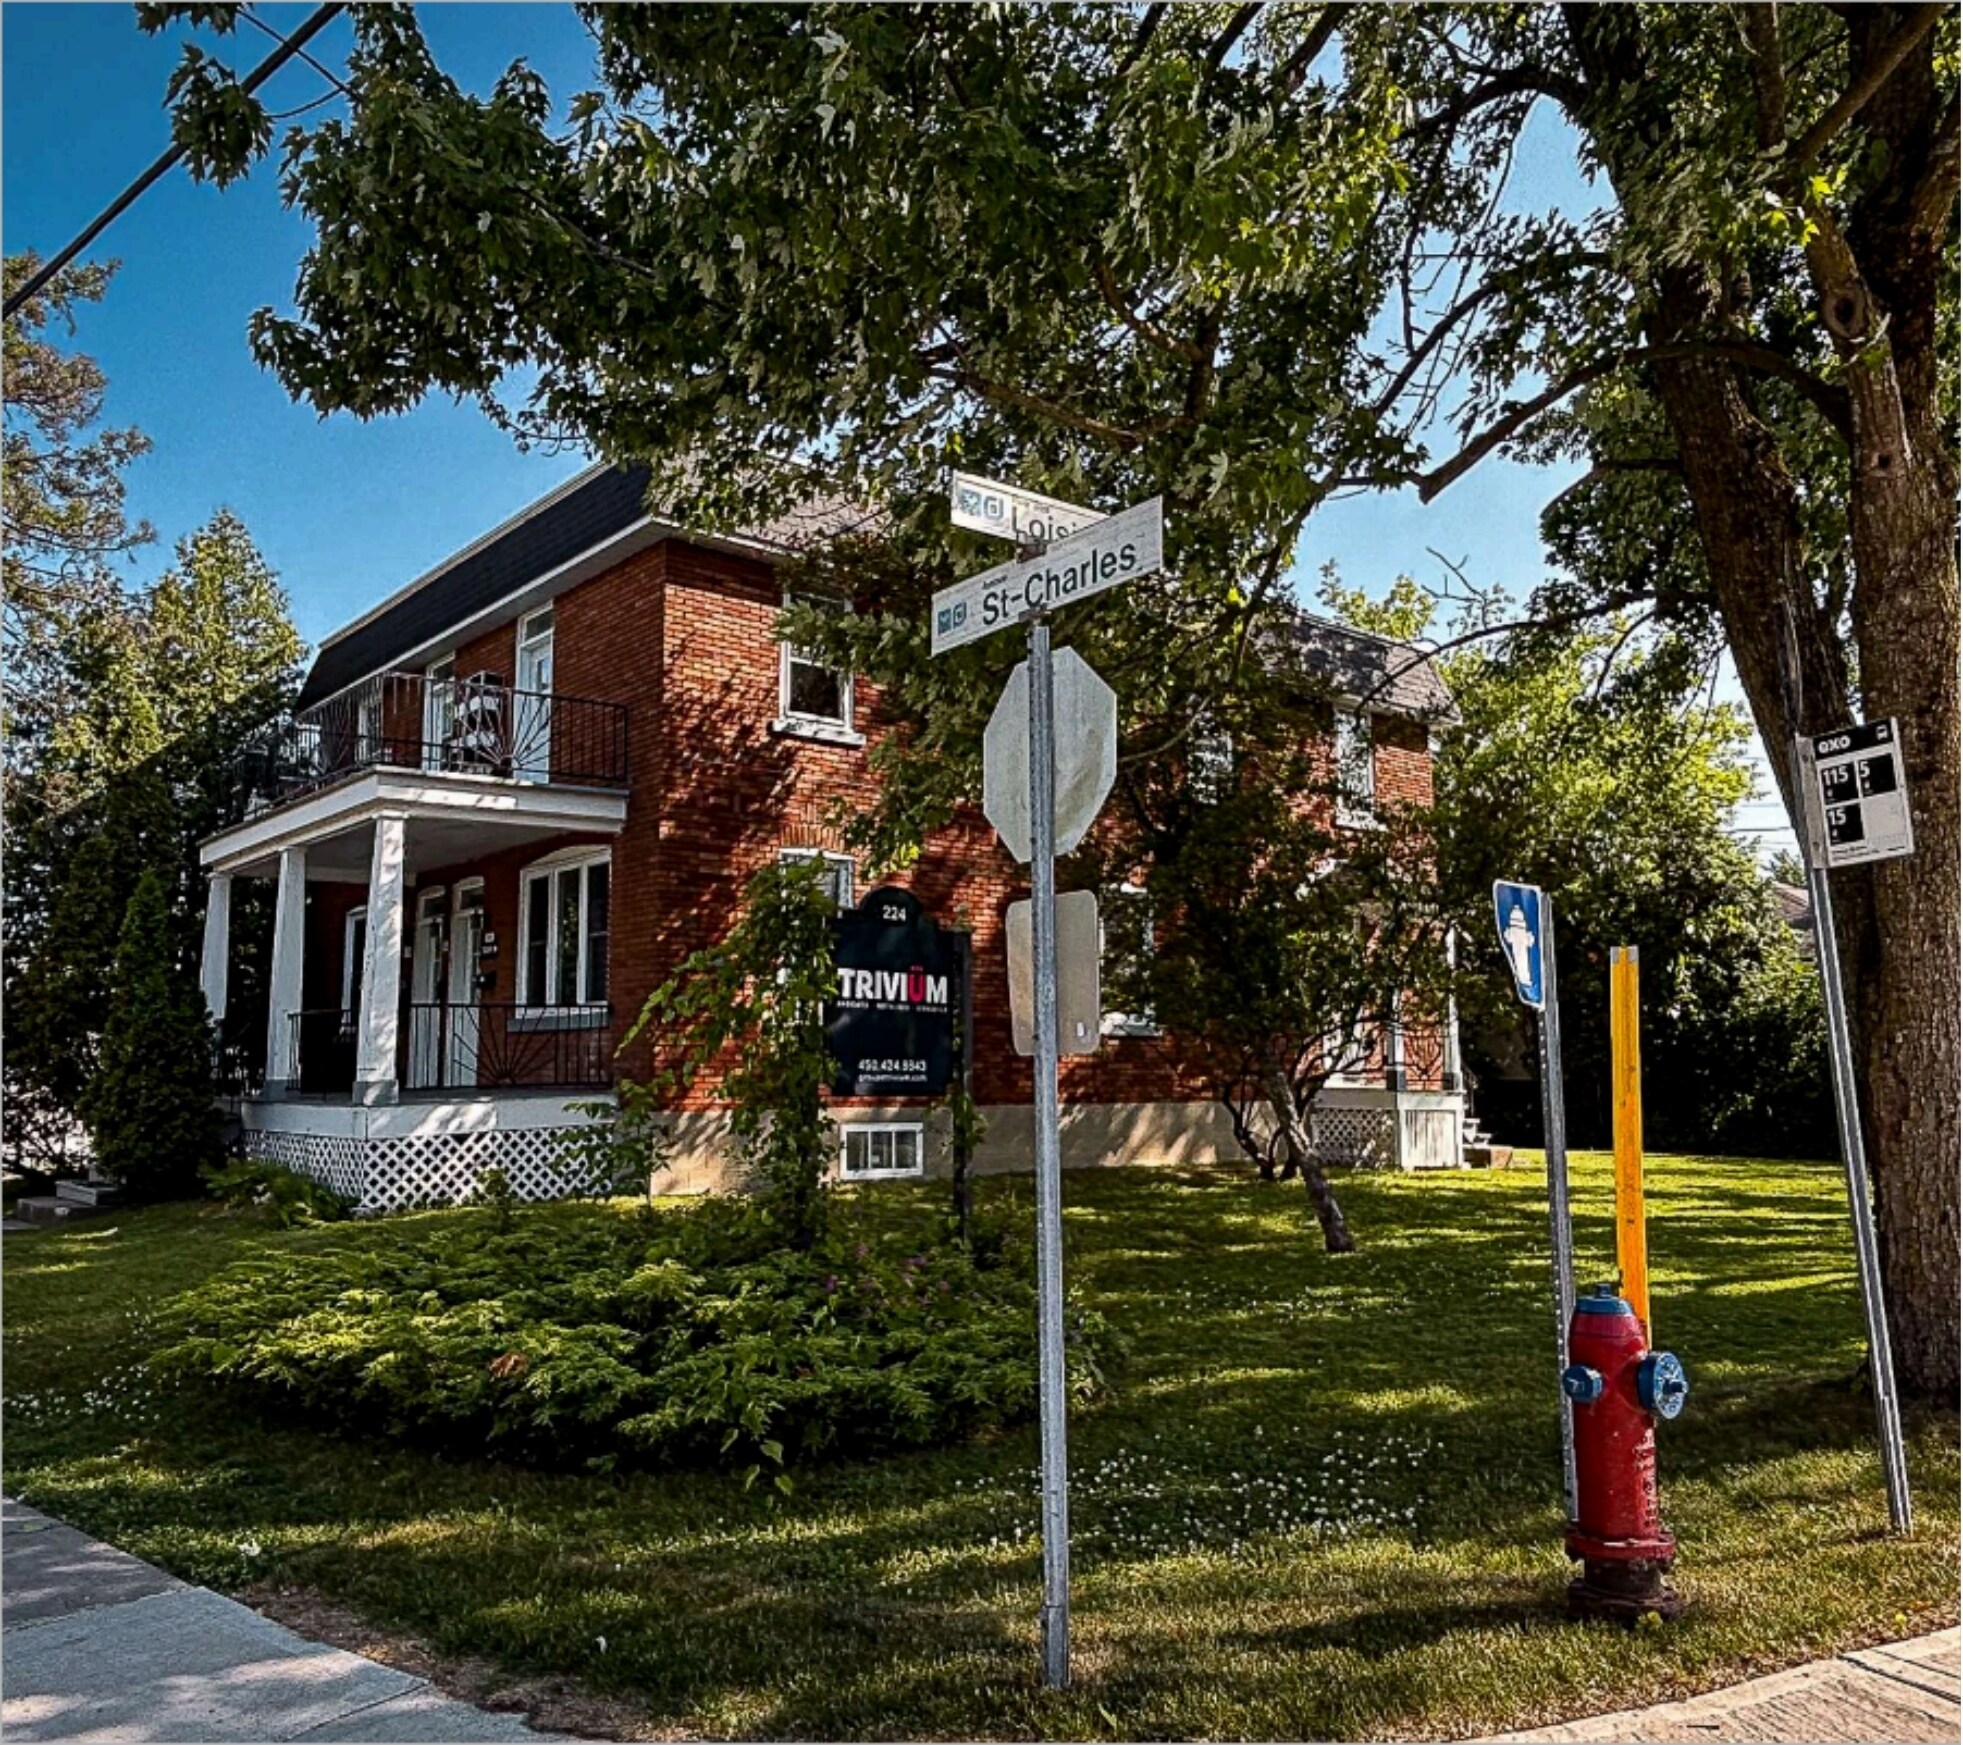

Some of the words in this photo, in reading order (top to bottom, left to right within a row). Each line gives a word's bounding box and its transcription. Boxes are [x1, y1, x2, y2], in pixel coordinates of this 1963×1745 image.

[982, 542, 1136, 625] St-Charles
[1823, 765, 1849, 786] 115
[1859, 761, 1871, 777] 5
[1828, 808, 1847, 826] 15
[883, 904, 907, 921] 224
